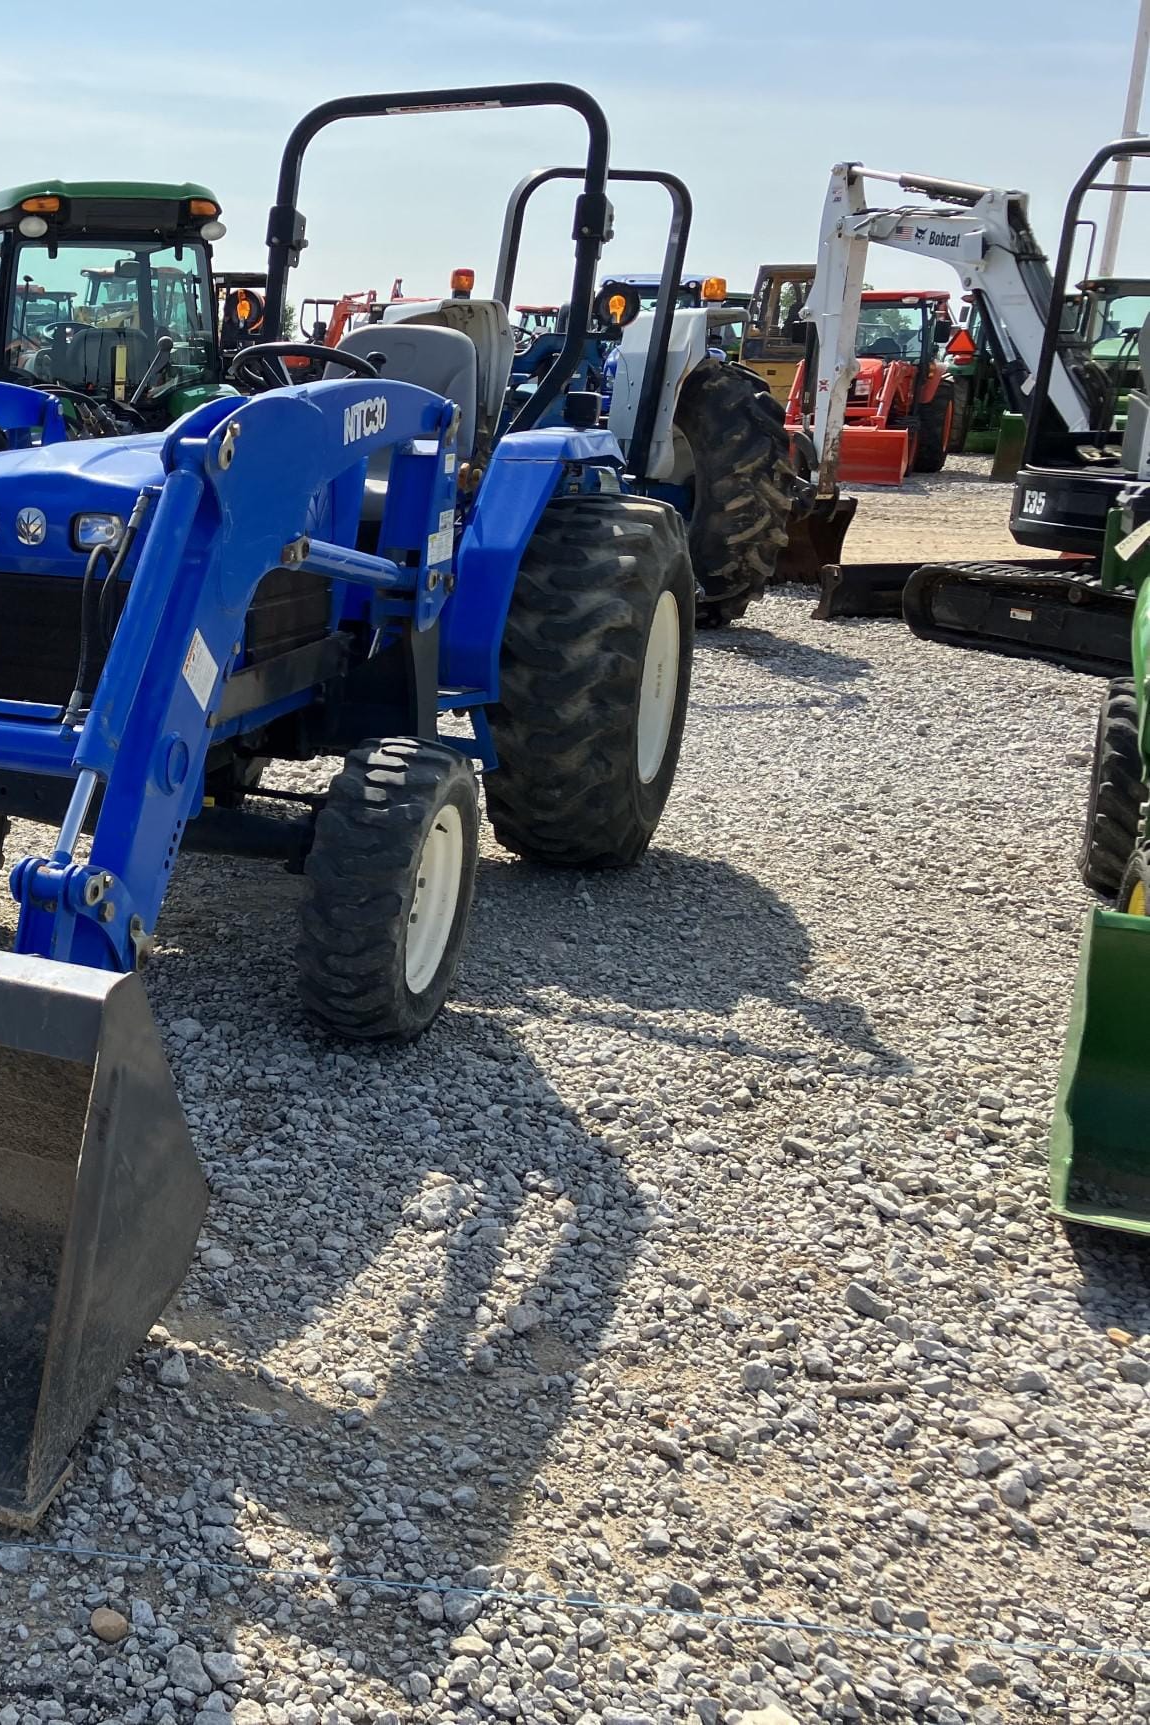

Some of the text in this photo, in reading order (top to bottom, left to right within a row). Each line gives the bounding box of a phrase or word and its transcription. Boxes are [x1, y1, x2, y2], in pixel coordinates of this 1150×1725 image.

[929, 231, 961, 248] Bobcat
[343, 395, 387, 446] NTC30
[1022, 489, 1047, 515] E35
